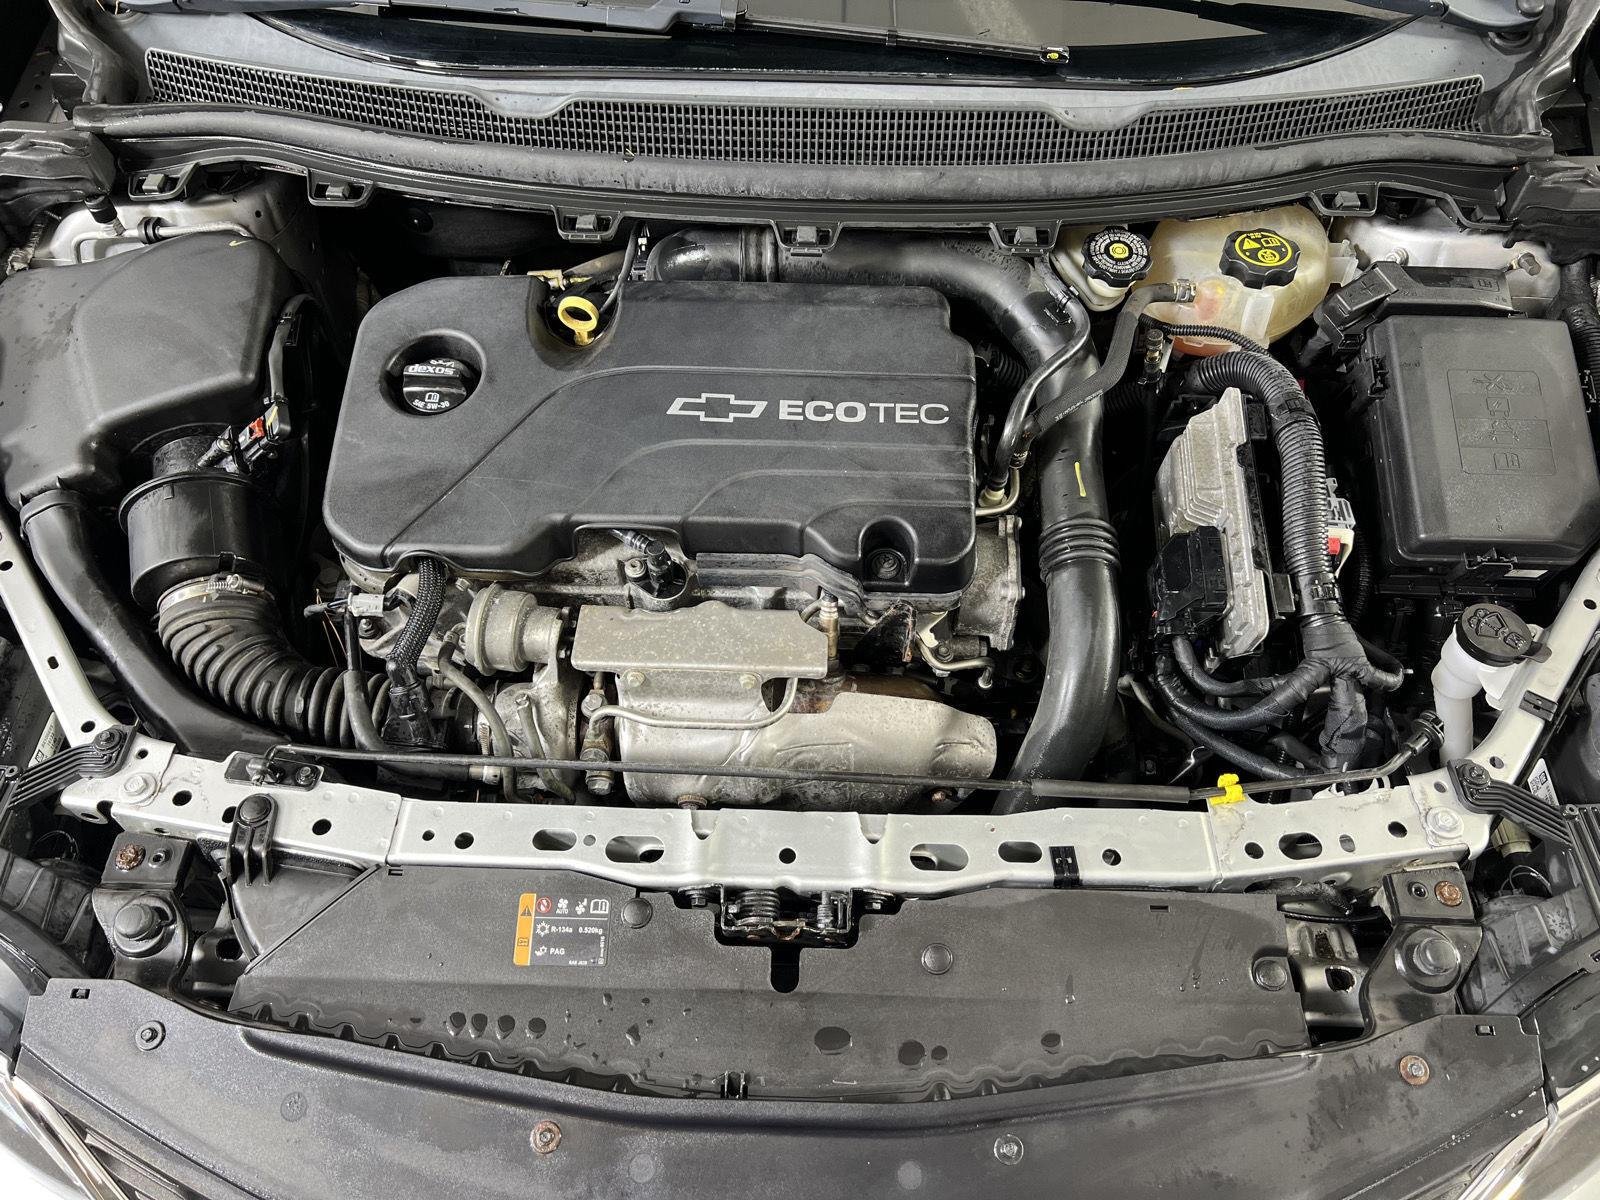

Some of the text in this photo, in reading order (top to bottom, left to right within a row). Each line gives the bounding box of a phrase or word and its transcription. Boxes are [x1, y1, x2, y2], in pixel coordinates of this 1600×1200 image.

[408, 364, 456, 375] dexos
[412, 399, 449, 409] SAE 5W-30
[779, 400, 950, 425] ECOTEC
[578, 926, 603, 935] 0.520kg
